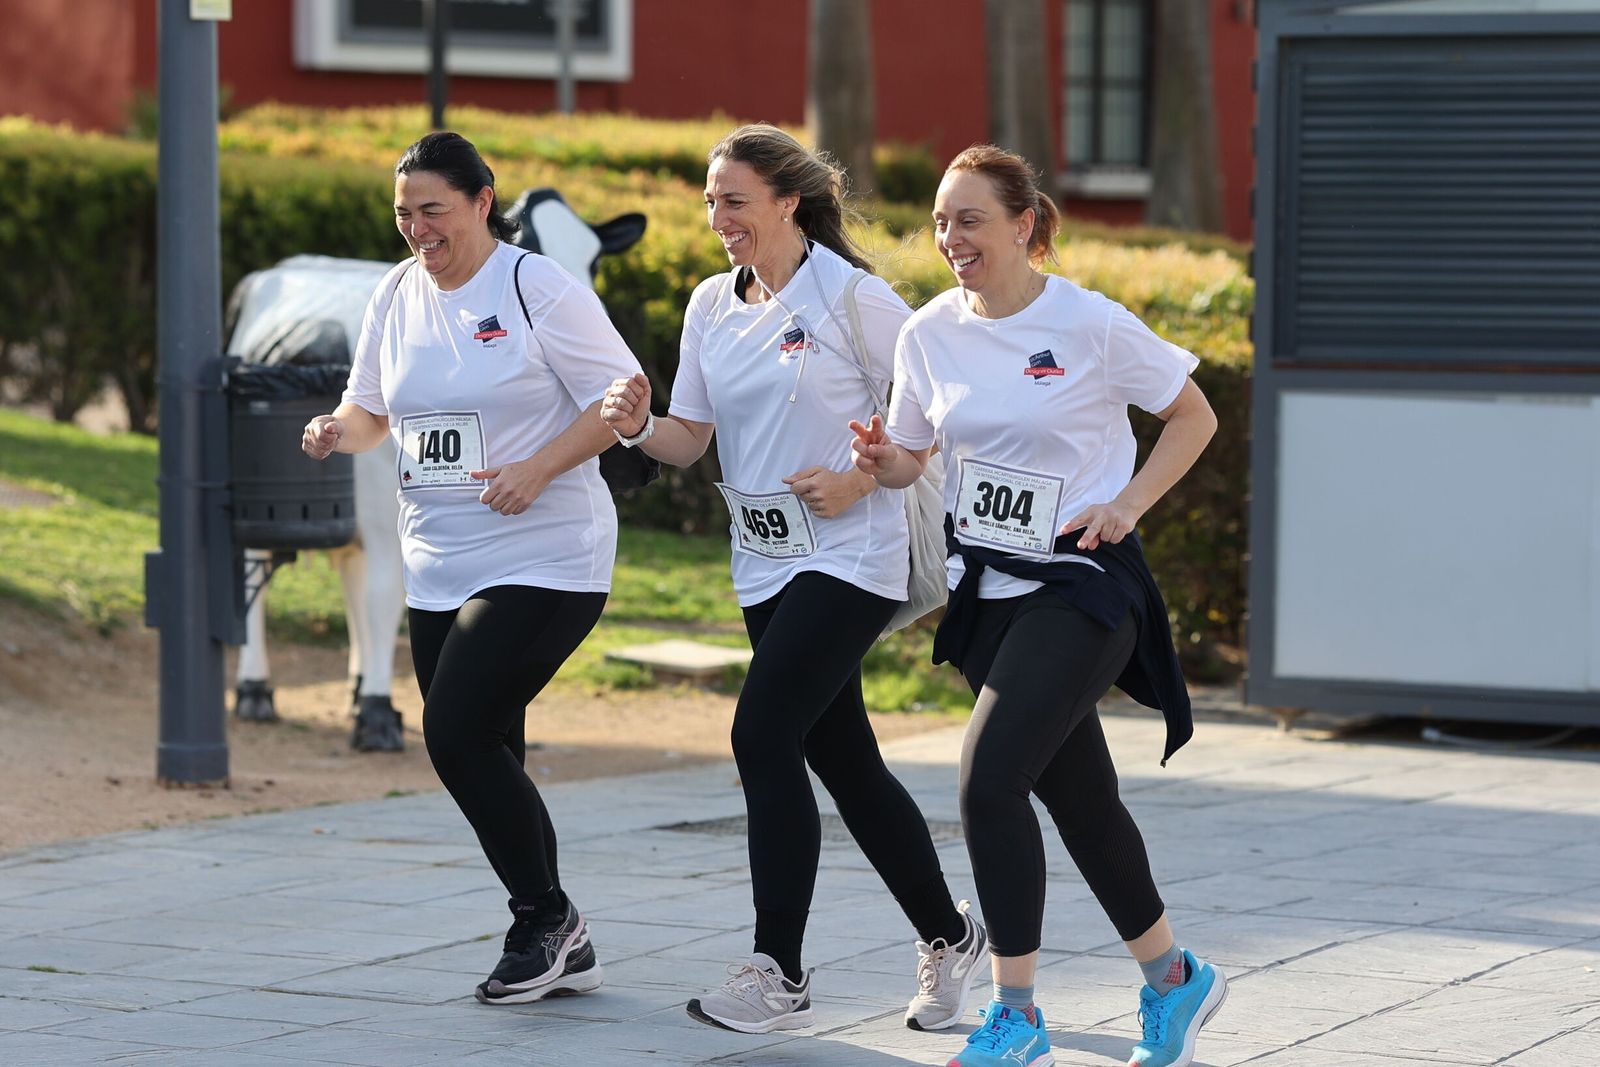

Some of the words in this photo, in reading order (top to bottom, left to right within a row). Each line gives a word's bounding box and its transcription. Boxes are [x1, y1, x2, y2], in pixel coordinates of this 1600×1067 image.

[418, 429, 461, 464] 140
[974, 466, 994, 474] CARRERA
[1031, 477, 1052, 486] MÁLAGA
[980, 472, 1014, 485] INTERNACIONAL
[973, 481, 1034, 526] 304
[741, 505, 789, 539] 469
[995, 521, 1012, 532] SÁNCHEZ,
